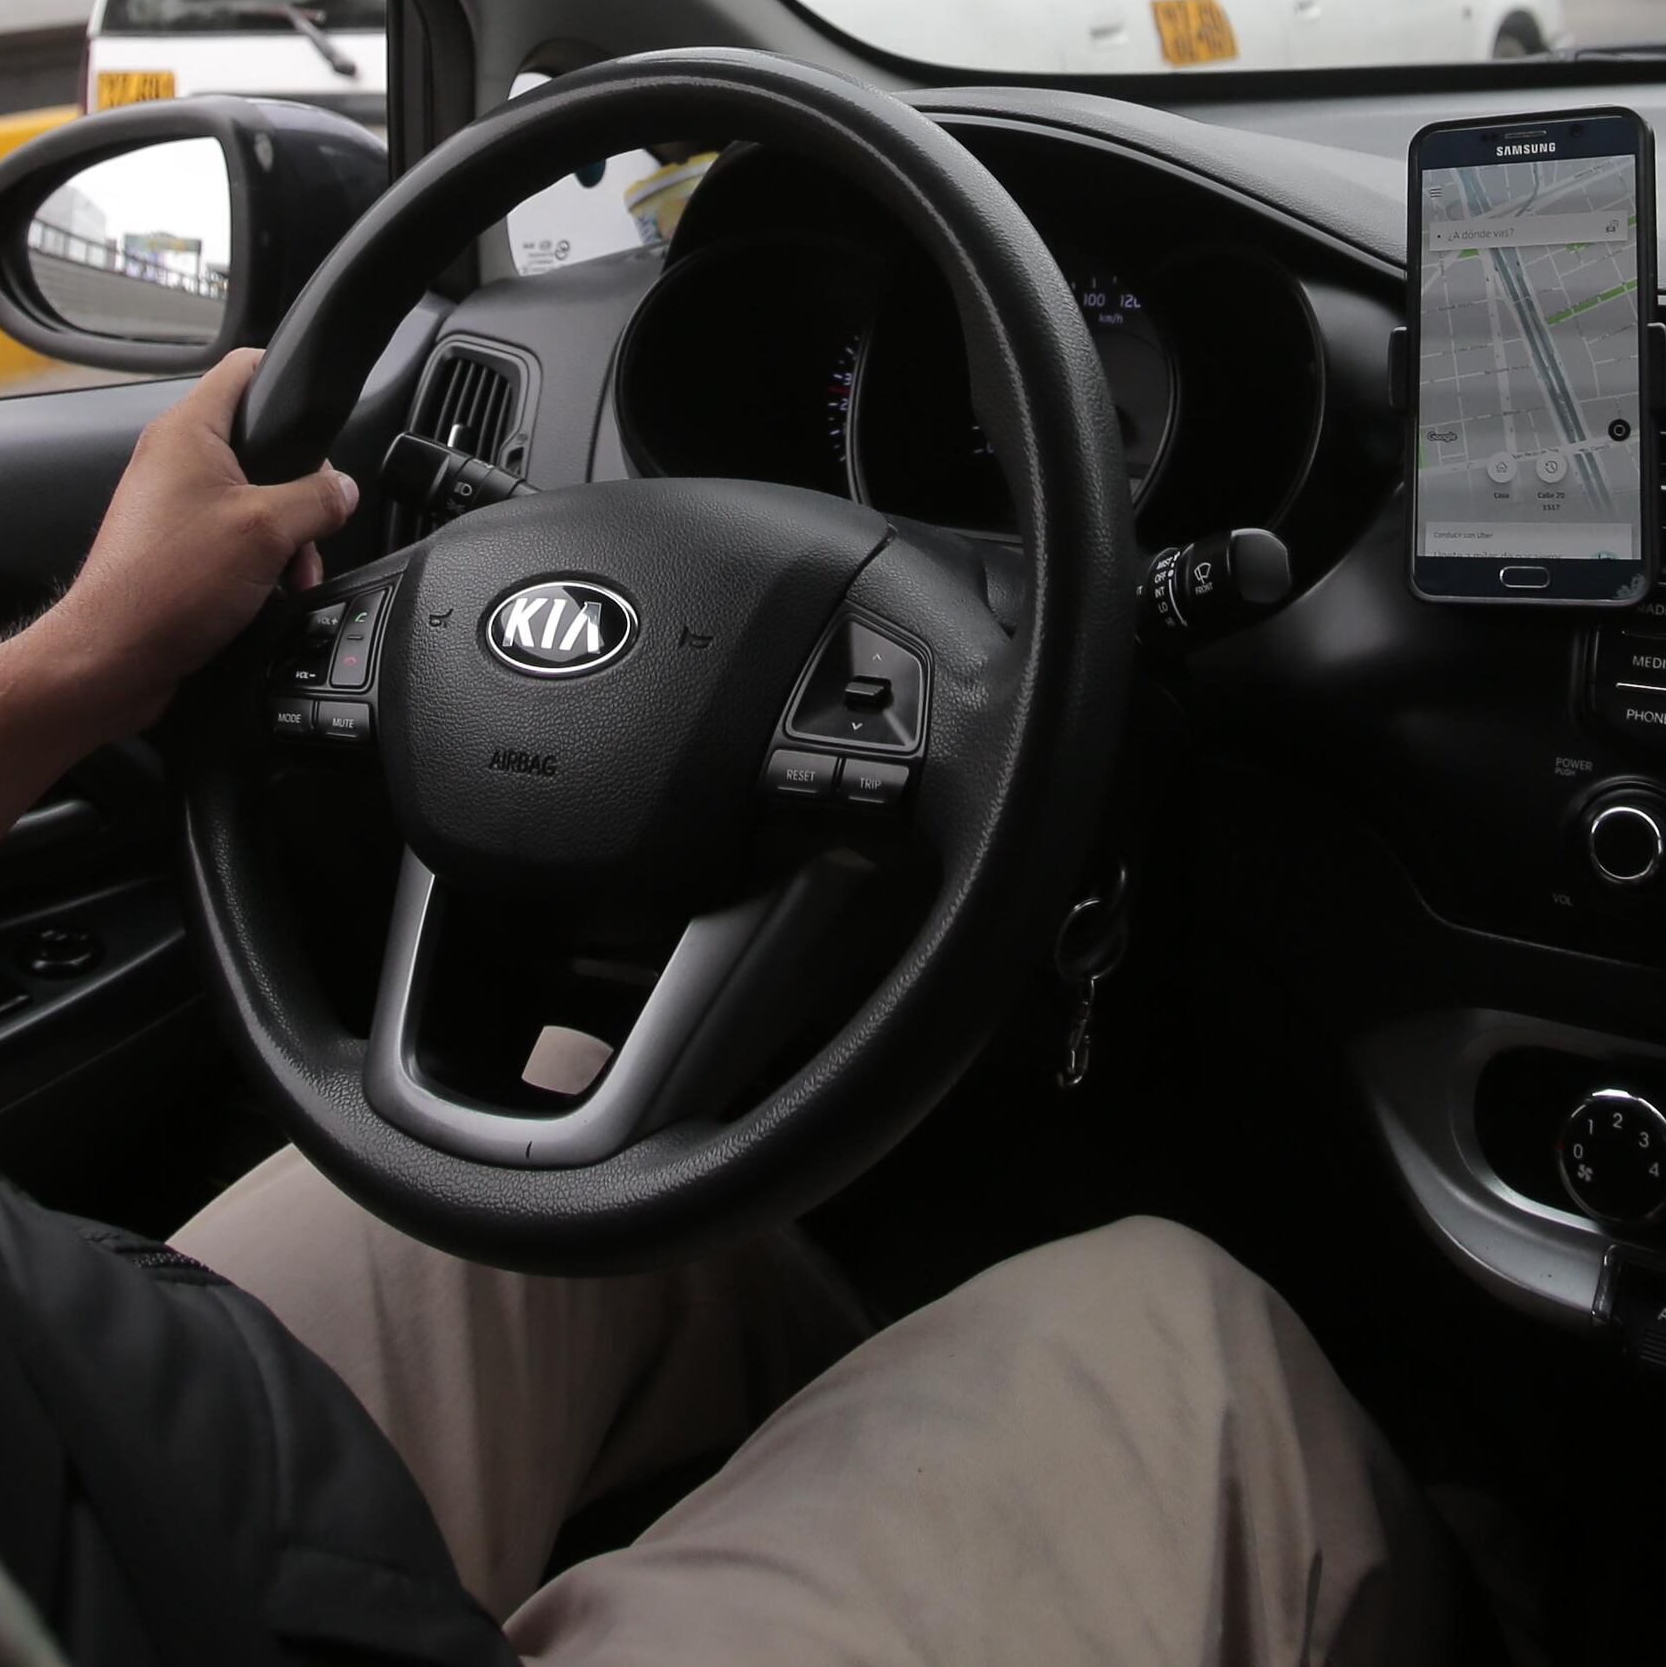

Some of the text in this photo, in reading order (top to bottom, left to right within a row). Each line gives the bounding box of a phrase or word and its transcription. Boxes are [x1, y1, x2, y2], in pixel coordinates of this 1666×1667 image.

[1496, 142, 1556, 157] SAMSUNG
[1461, 227, 1491, 239] dónde
[1493, 228, 1514, 239] vas?
[1083, 294, 1105, 307] 100
[1098, 313, 1123, 324] km/h
[1427, 430, 1458, 443] Google
[502, 598, 602, 654] KIA
[278, 713, 302, 724] MODE
[332, 718, 355, 729] MUTE
[489, 750, 557, 776] AIRBAG
[1556, 757, 1593, 772] POWER
[786, 769, 816, 782] RESET
[860, 777, 882, 790] TRIP
[1552, 893, 1573, 908] VOL
[1588, 1119, 1593, 1135] 1
[1613, 1112, 1623, 1128] 2
[1638, 1131, 1649, 1147] 3
[1573, 1143, 1583, 1159] 0
[1648, 1162, 1659, 1177] 4
